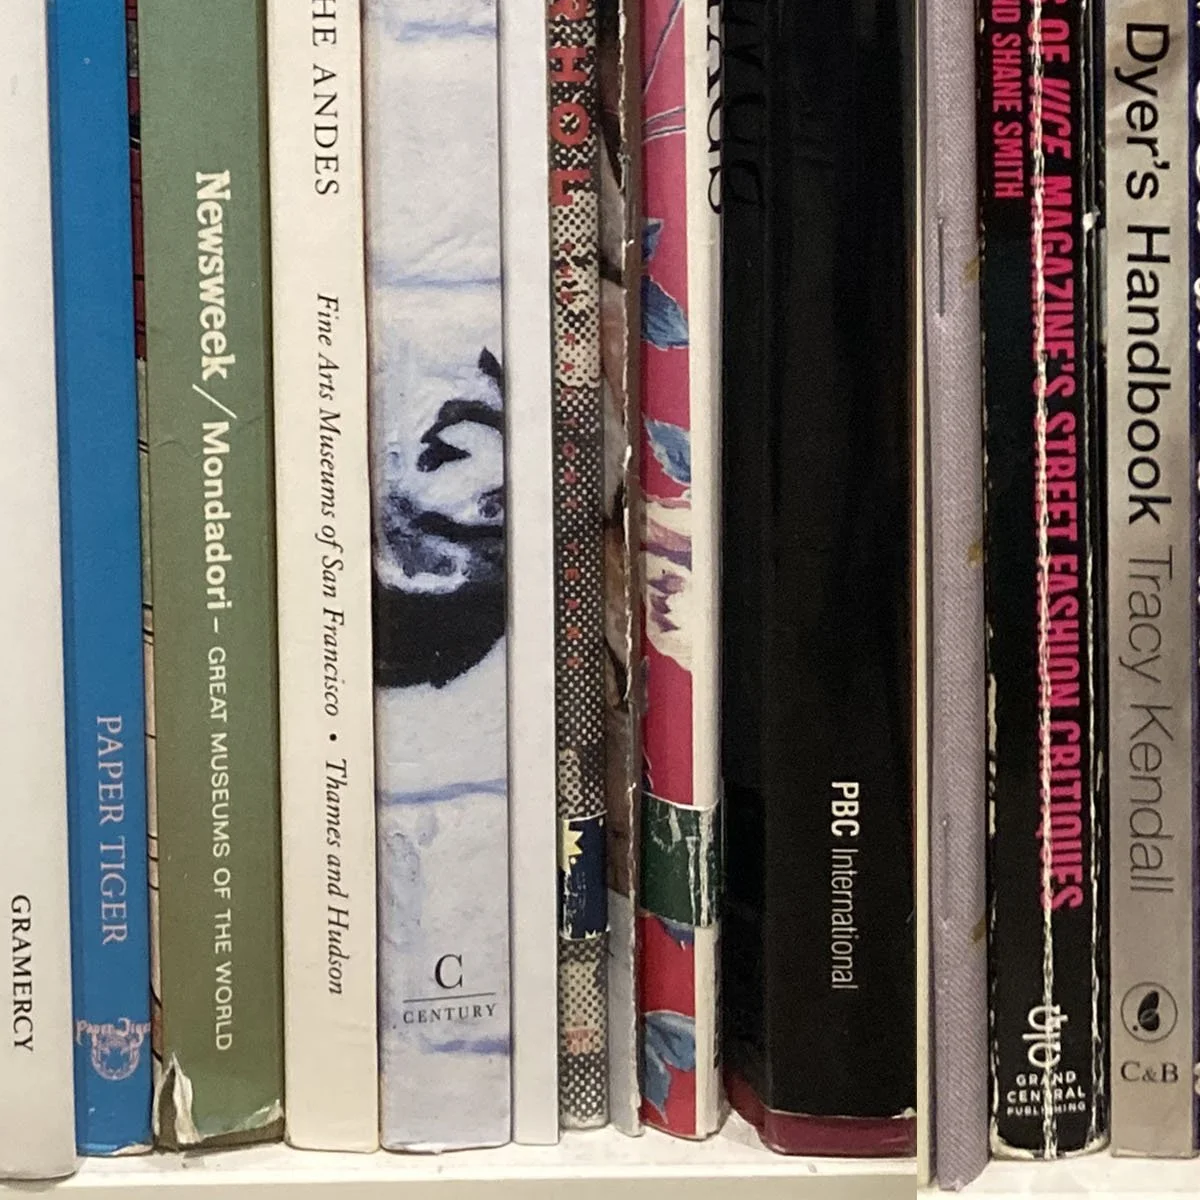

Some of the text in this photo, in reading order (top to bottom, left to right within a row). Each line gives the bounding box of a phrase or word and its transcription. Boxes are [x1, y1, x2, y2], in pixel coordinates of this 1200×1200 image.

[992, 33, 1022, 112] SHANE
[1028, 19, 1070, 63] OF
[313, 65, 339, 195] ANDES
[993, 121, 1023, 198] SMITH
[1029, 77, 1072, 158] VICE
[317, 293, 339, 346] Fine
[319, 352, 339, 400] Arts
[1127, 226, 1172, 524] Handbook
[319, 408, 342, 518] Museums
[1033, 412, 1077, 540] STREET
[315, 524, 343, 553] of
[323, 555, 344, 598] San
[1035, 554, 1079, 707] FASHION
[1118, 545, 1173, 684] Tracy
[208, 647, 227, 722] GREAT
[323, 608, 344, 716] Francisco
[97, 716, 127, 944] PAPER TIGER
[211, 733, 230, 857] MUSEUMS
[325, 758, 348, 848] Thames
[1036, 721, 1083, 909] CRITIQUES
[1129, 704, 1174, 892] Kendall
[214, 868, 230, 898] OF
[327, 853, 349, 899] and
[831, 782, 859, 988] PBC International
[12, 895, 33, 1050] GRAMERCY
[215, 909, 231, 953] THE
[327, 904, 350, 995] Hudson
[435, 955, 462, 989] C
[215, 961, 232, 1050] WORLD
[403, 1003, 497, 1025] CENTURY
